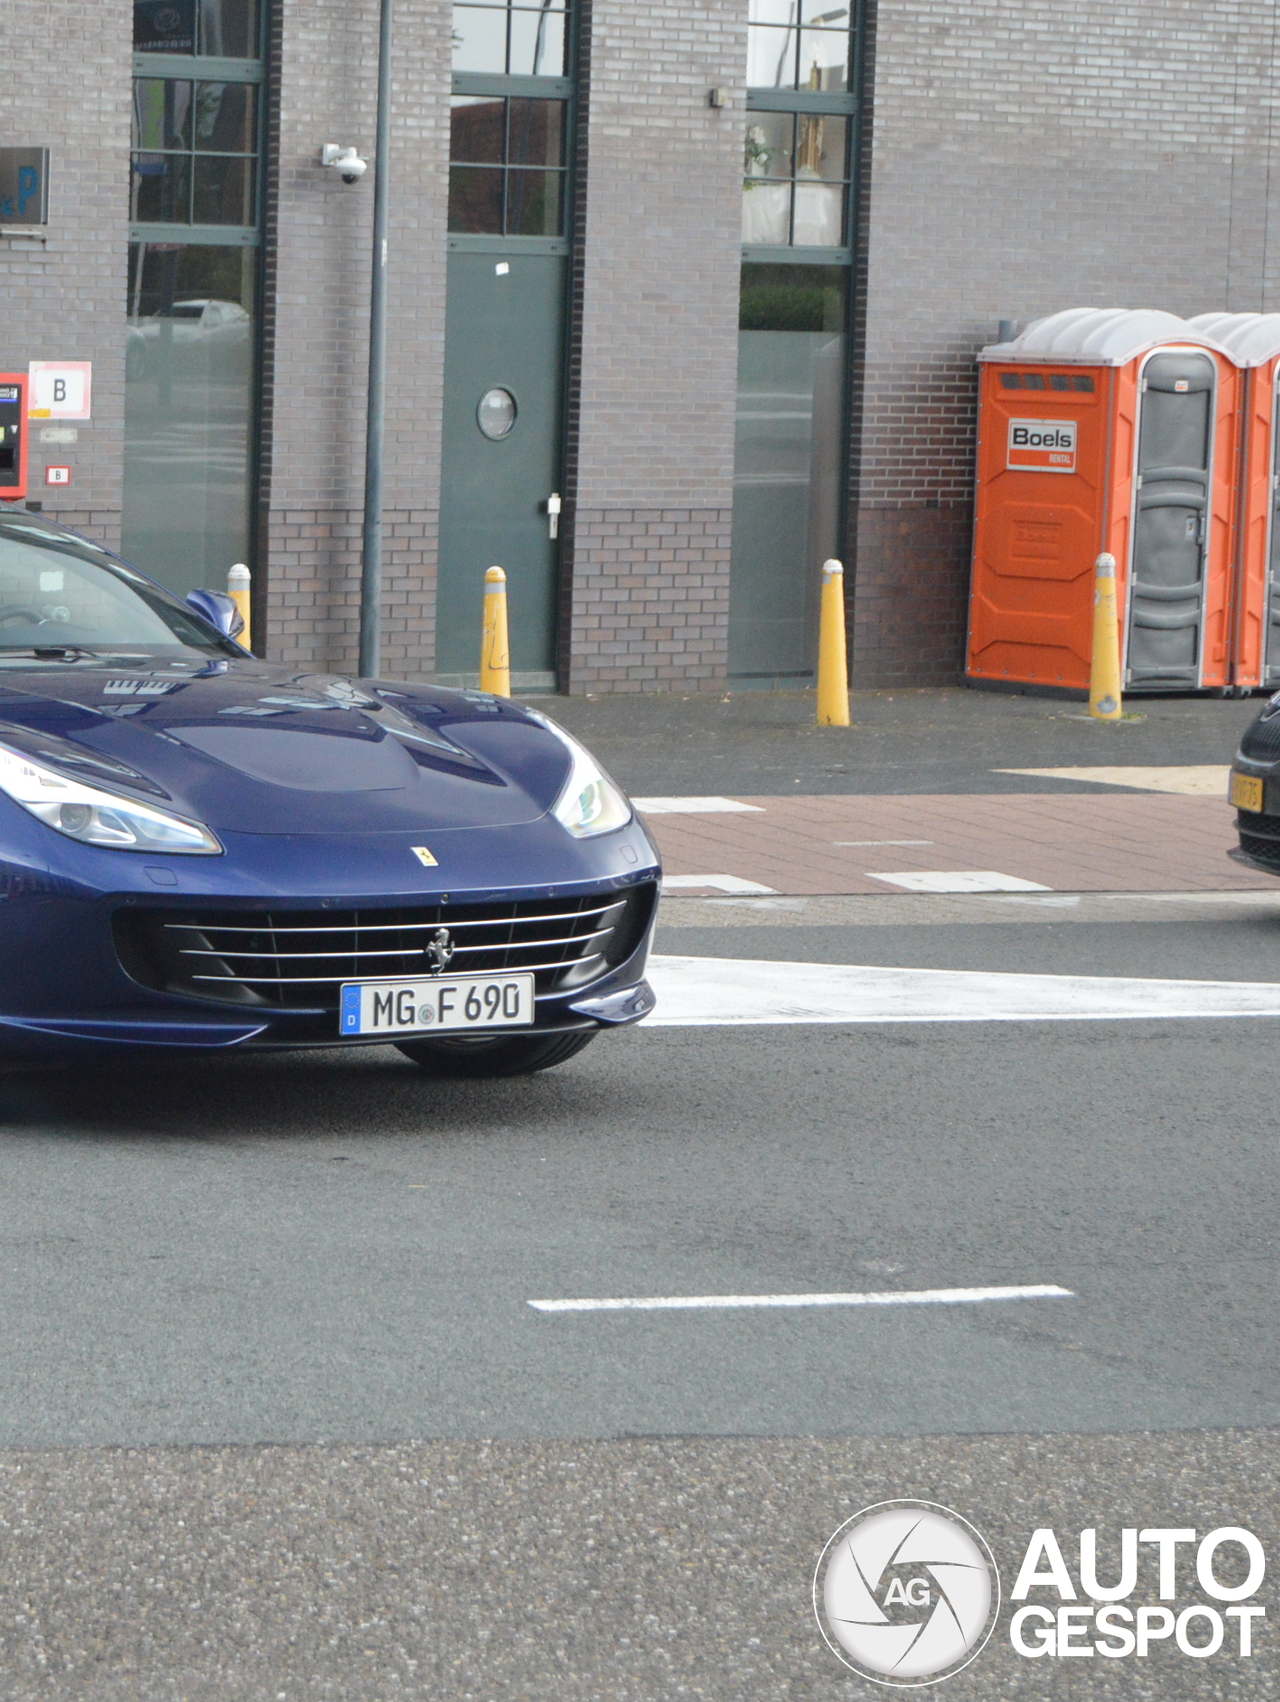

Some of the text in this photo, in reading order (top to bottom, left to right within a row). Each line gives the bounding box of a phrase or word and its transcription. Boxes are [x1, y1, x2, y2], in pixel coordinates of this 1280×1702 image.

[19, 166, 38, 215] P
[54, 379, 66, 401] B
[1013, 427, 1071, 447] Boels
[1049, 453, 1071, 463] RENTAL
[56, 470, 61, 480] B
[373, 983, 520, 1027] MG F 690
[347, 1015, 356, 1026] D
